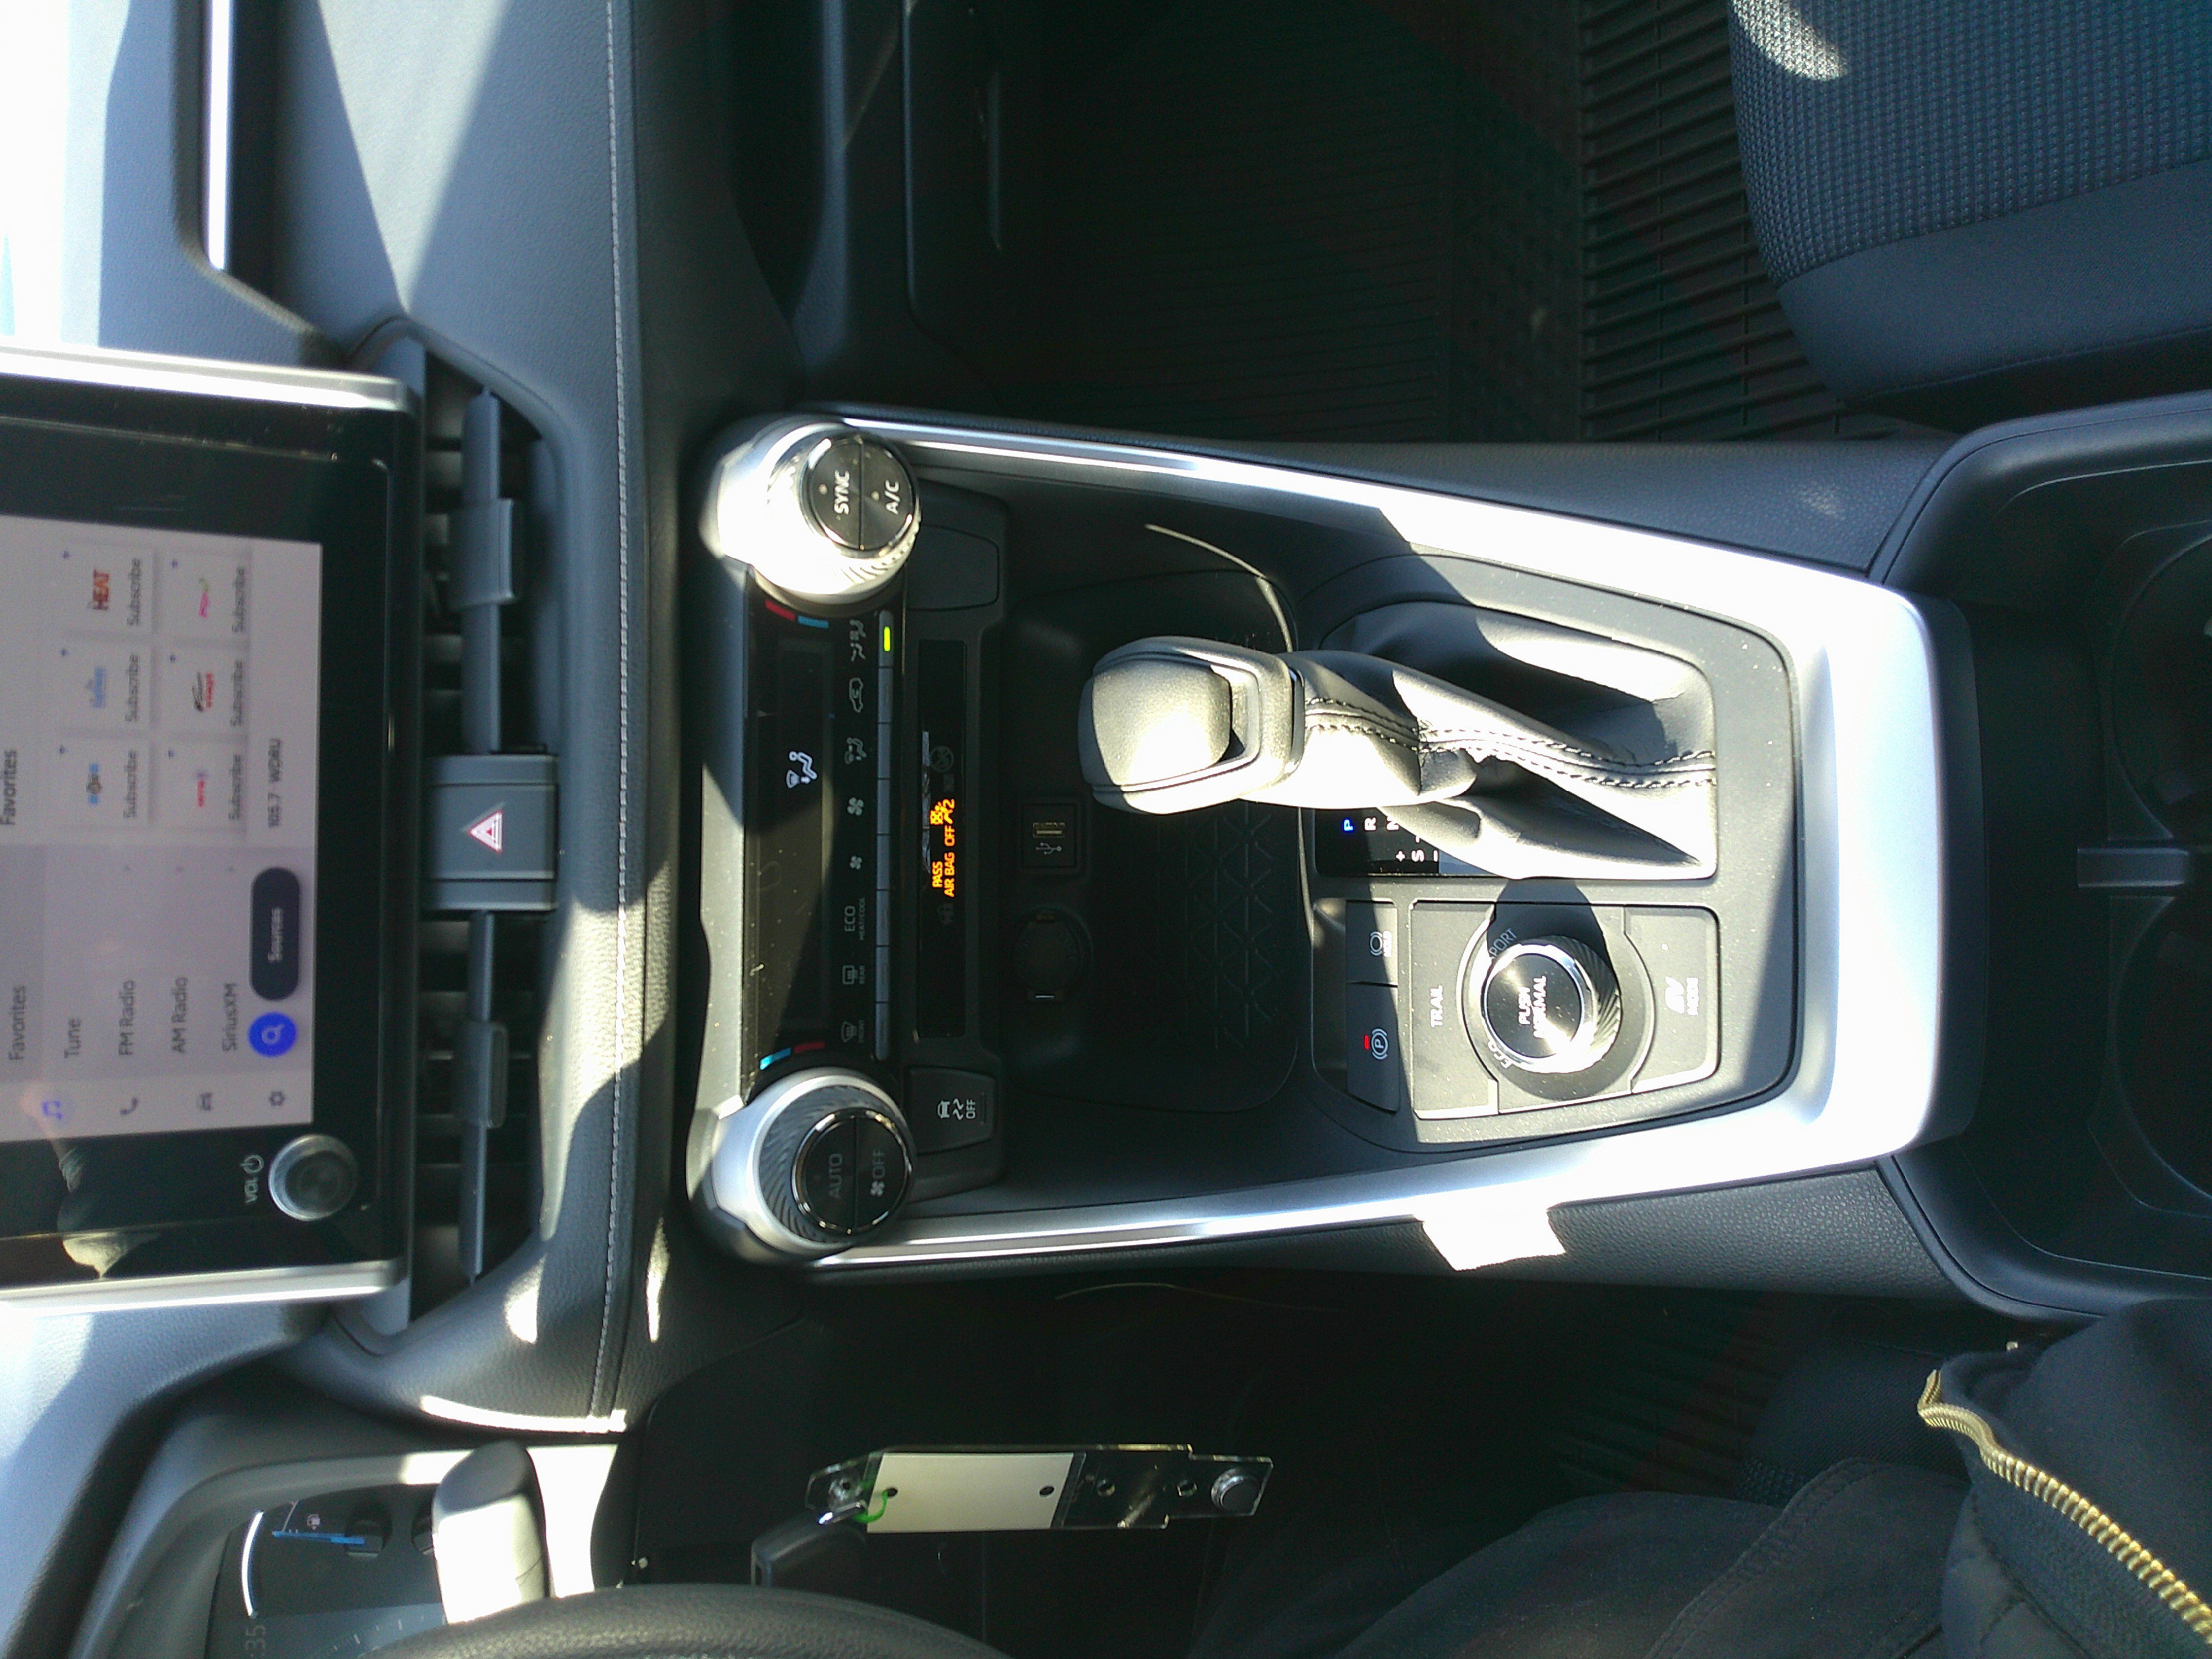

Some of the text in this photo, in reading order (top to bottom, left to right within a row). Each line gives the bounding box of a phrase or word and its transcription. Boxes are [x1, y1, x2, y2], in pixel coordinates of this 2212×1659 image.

[834, 469, 850, 515] SYNC
[885, 481, 900, 515] A/C
[127, 558, 141, 627] Subscribe
[232, 567, 246, 633] Subscribe
[124, 654, 138, 722] Subscribe
[230, 660, 243, 727] Subscribe
[0, 749, 17, 826] Favorites
[123, 750, 137, 818] Subscribe
[228, 754, 242, 821] Subscribe
[1343, 819, 1353, 831] P
[1364, 817, 1376, 831] R
[932, 861, 943, 888] PASS
[943, 825, 955, 898] AIR BAG OFF
[1411, 849, 1425, 862] S
[267, 907, 283, 962] Sources
[844, 905, 856, 932] ECO
[1489, 927, 1517, 959] PORT
[9, 986, 25, 1060] Favorites
[119, 980, 135, 1056] FM Radio
[171, 977, 187, 1053] AM Radio
[222, 983, 237, 1051] SiriusXM
[1430, 984, 1444, 1028] TRAIL
[1517, 986, 1531, 1025] PUSH
[65, 1019, 82, 1058] Tune
[966, 1099, 976, 1119] OFF
[828, 1153, 842, 1199] AUTO
[872, 1150, 885, 1180] OFF
[244, 1177, 258, 1203] VOL
